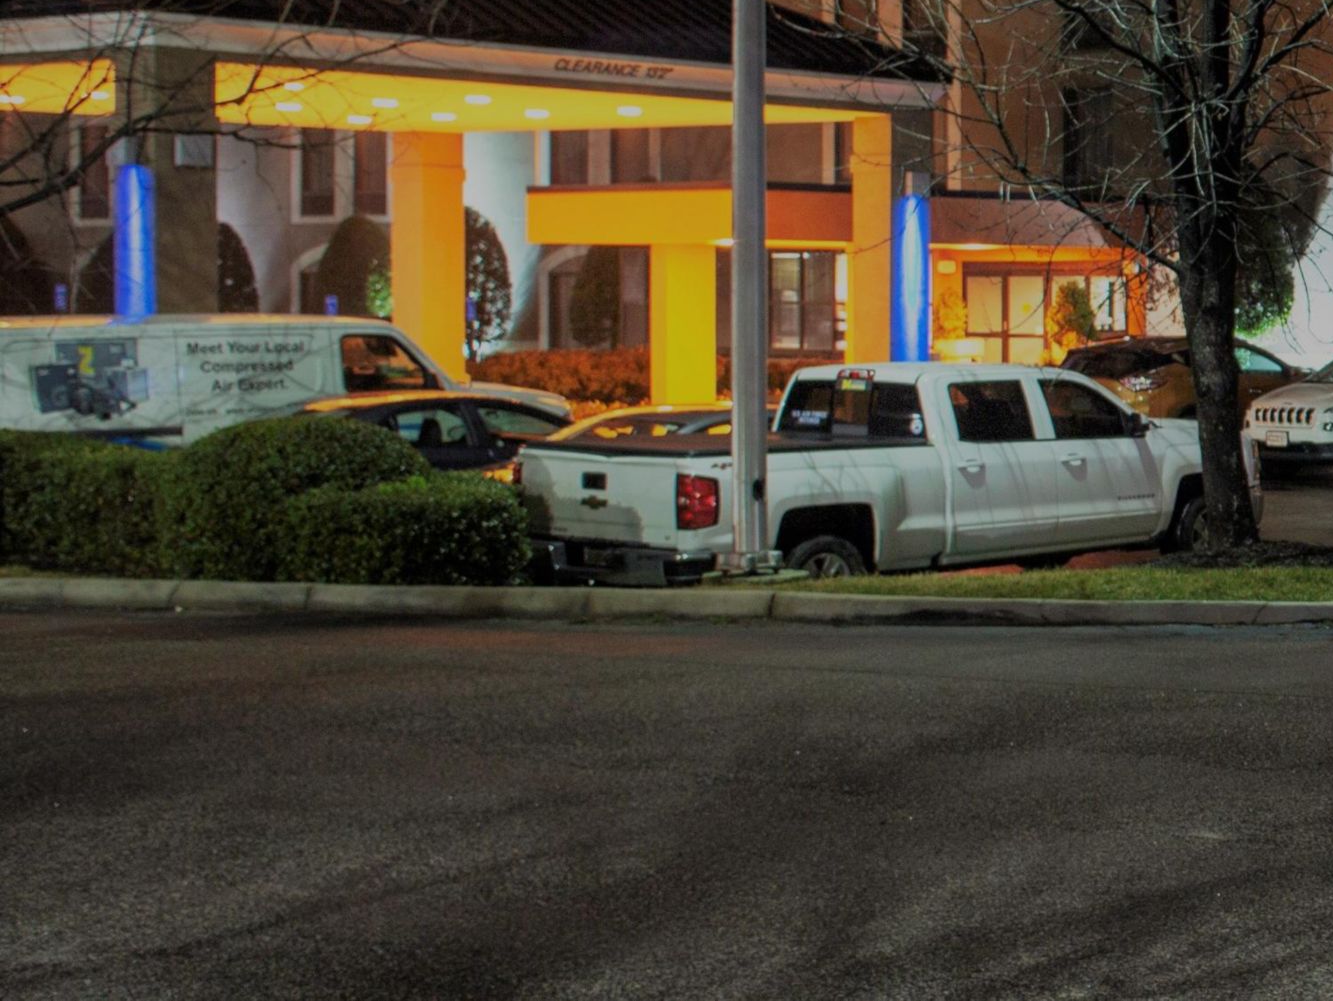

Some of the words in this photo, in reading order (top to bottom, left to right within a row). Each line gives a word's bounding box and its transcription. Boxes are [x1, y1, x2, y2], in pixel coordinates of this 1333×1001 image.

[554, 58, 641, 78] CLEARANCE
[186, 341, 223, 355] Meet
[227, 342, 260, 353] Your
[264, 341, 304, 353] Local
[200, 360, 294, 374] Compressed
[212, 379, 233, 391] Air
